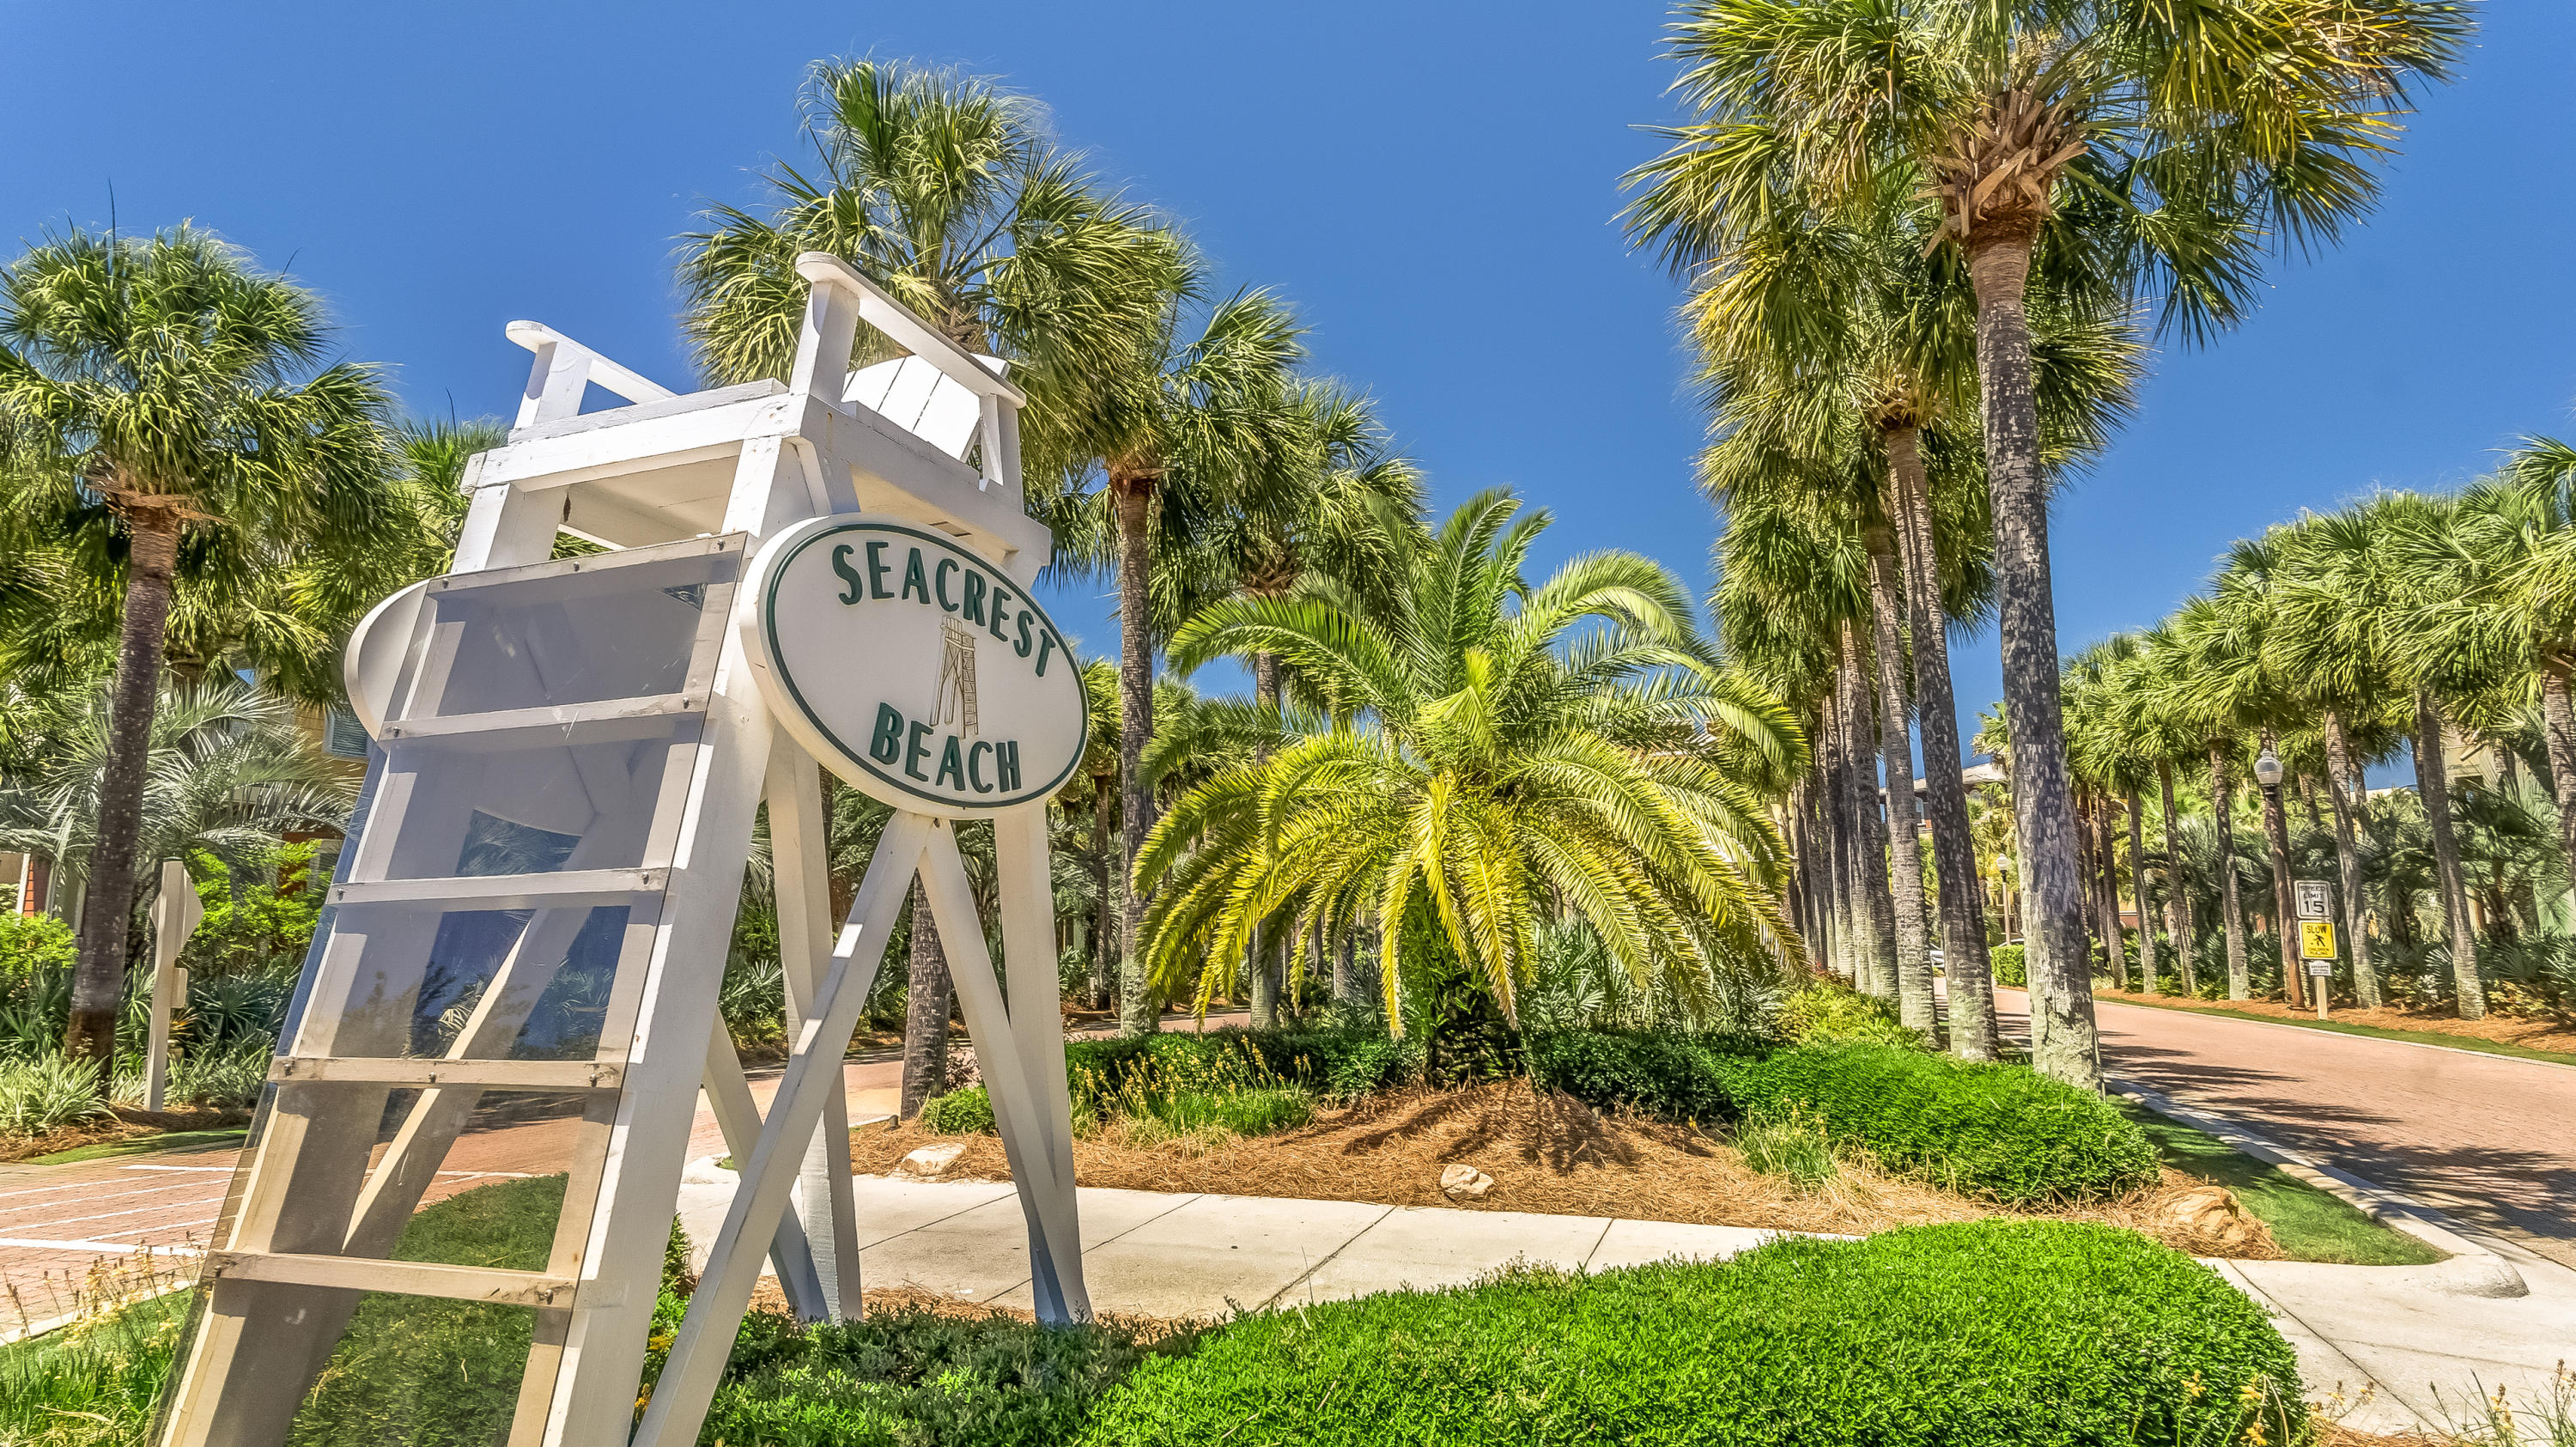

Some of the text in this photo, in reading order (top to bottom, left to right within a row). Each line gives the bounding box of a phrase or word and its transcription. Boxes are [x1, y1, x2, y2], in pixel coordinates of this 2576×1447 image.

[831, 541, 1056, 678] SEACREST
[869, 702, 1022, 793] BEACH
[2304, 900, 2325, 913] 15
[2306, 925, 2327, 933] SLOW
